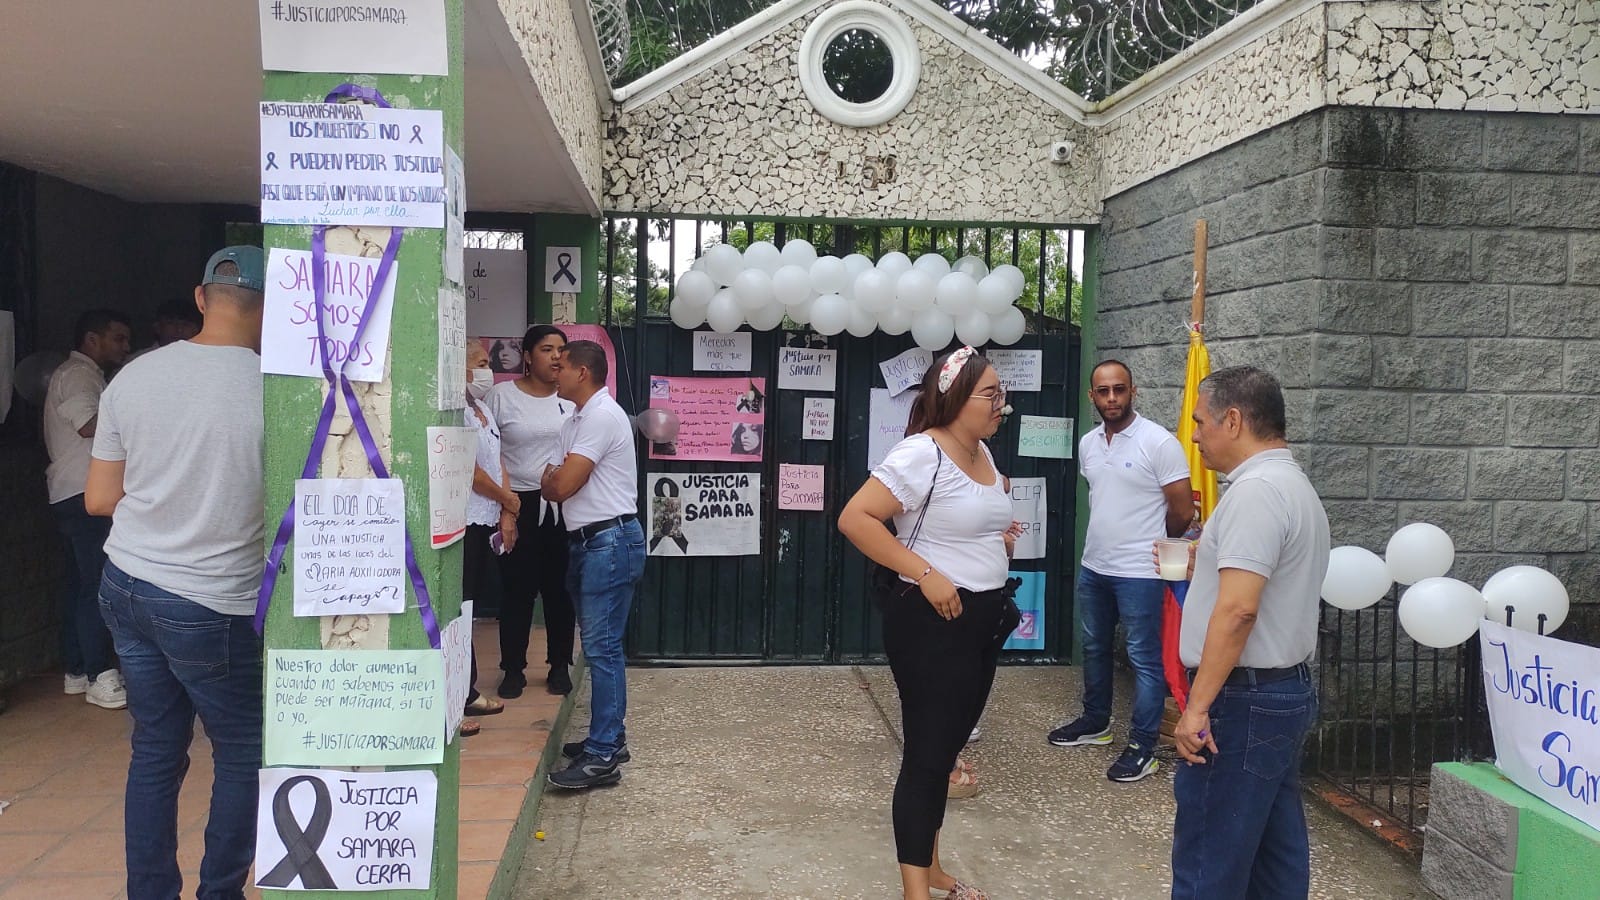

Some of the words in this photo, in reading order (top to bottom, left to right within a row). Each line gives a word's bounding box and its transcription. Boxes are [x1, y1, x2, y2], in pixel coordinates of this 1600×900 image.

[289, 122, 313, 138] LOS
[314, 122, 370, 139] MUERTOS
[380, 123, 400, 141] NO
[290, 153, 342, 170] PUEDEN
[345, 153, 387, 171] PEDIR
[319, 202, 359, 217] Luchar
[362, 206, 382, 218] por
[682, 474, 749, 489] JUSTICIA
[303, 494, 326, 517] EL
[366, 494, 388, 517] DE
[699, 489, 740, 503] PARA
[684, 503, 755, 522] SAMARA
[311, 533, 337, 546] UNA
[275, 656, 322, 673] Nuestro
[329, 657, 359, 673] dolor
[365, 660, 418, 675] aumenta
[275, 674, 317, 692] cuando
[321, 678, 336, 692] no
[1489, 641, 1599, 726] Justicia
[314, 694, 334, 708] ser
[365, 810, 402, 832] POR
[336, 836, 417, 860] SAMARA
[355, 863, 411, 886] CERPA
